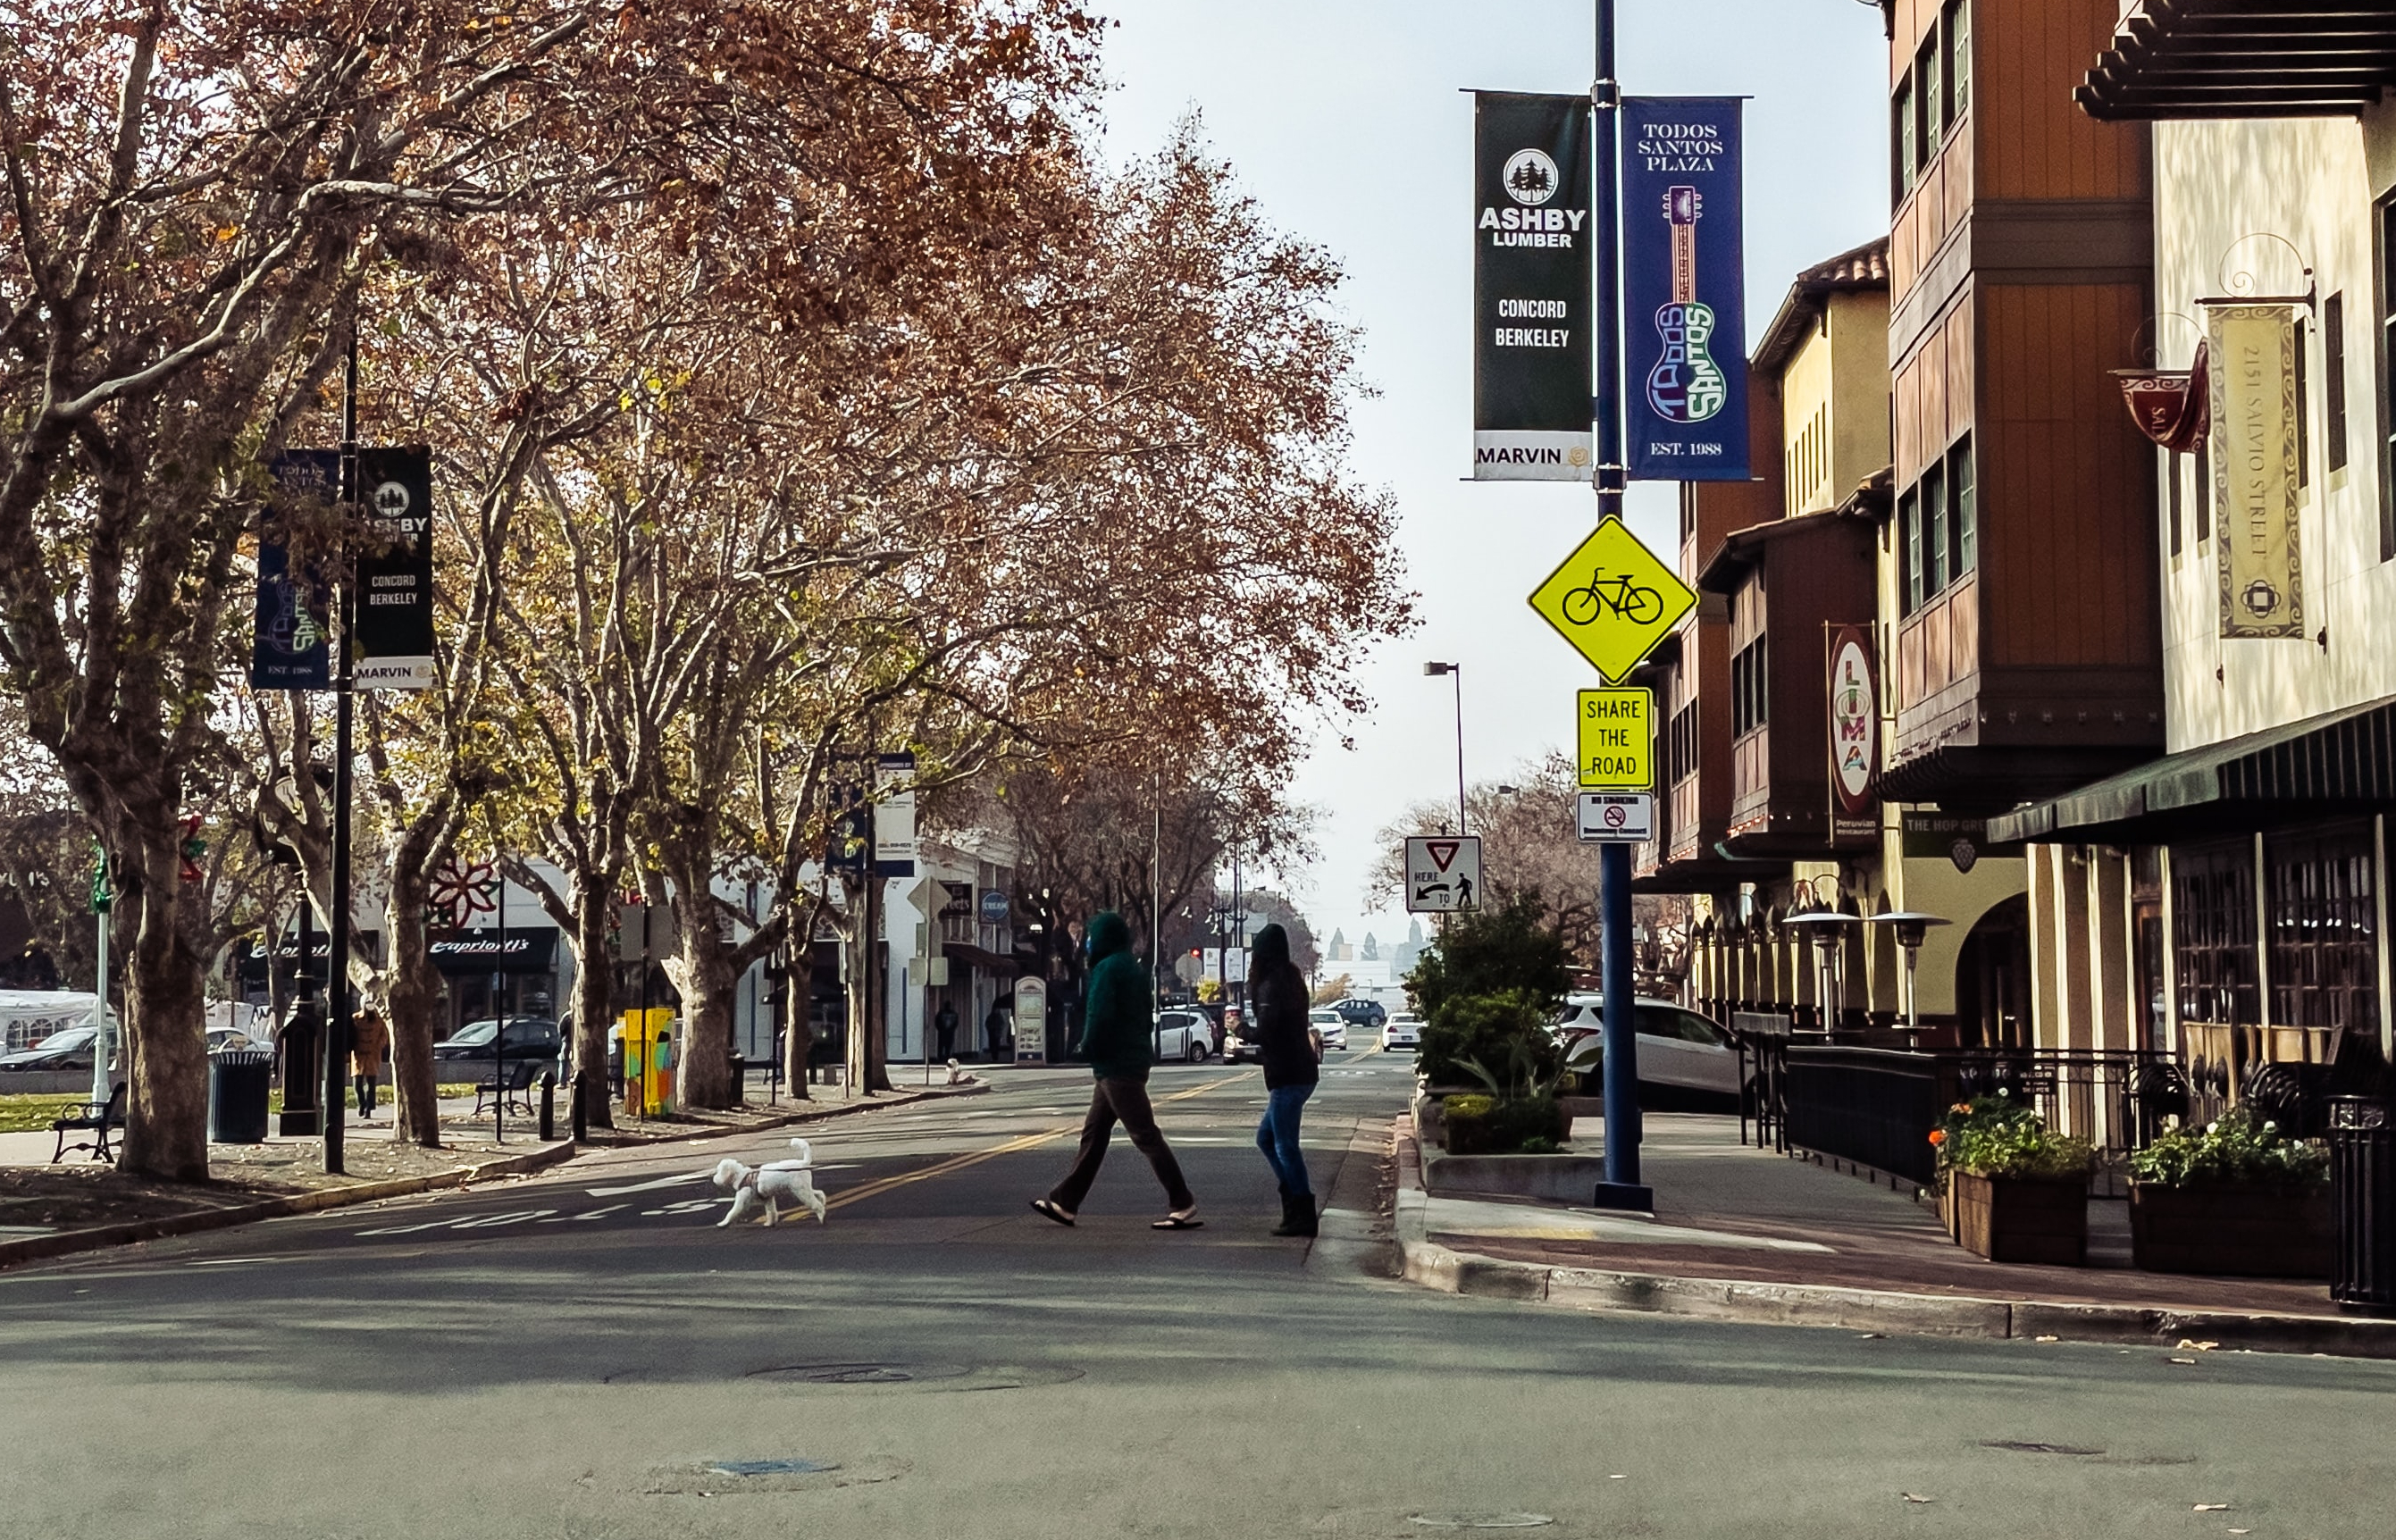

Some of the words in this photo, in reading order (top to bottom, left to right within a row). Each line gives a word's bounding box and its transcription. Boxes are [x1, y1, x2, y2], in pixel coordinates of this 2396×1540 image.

[1643, 123, 1718, 138] TODOS
[1638, 139, 1723, 155] SANTOS
[1647, 156, 1714, 172] PLAZA
[1479, 207, 1586, 231] ASHBY
[1493, 232, 1572, 247] LUMBER
[1498, 299, 1566, 318] CONCORD
[1495, 328, 1570, 347] BERKELEY
[1652, 307, 1686, 417] TODOS
[1686, 306, 1723, 419] SANTOS
[2244, 347, 2261, 387] 2151
[2246, 398, 2266, 473] SALVIO
[1477, 448, 1562, 464] MARVIN
[1651, 442, 1685, 456] EST.
[1689, 442, 1722, 456] 1988
[2249, 480, 2267, 556] STREET
[372, 574, 416, 587] CONCORD
[370, 592, 417, 605] BERKELEY
[357, 666, 412, 679] MARVIN
[1587, 700, 1641, 718] SHARE
[1598, 729, 1629, 746] THE
[1592, 757, 1637, 774] ROAD
[1907, 819, 1931, 832] THE
[1933, 820, 1957, 832] HOP
[1414, 872, 1439, 883] HERE
[1439, 893, 1451, 904] TO
